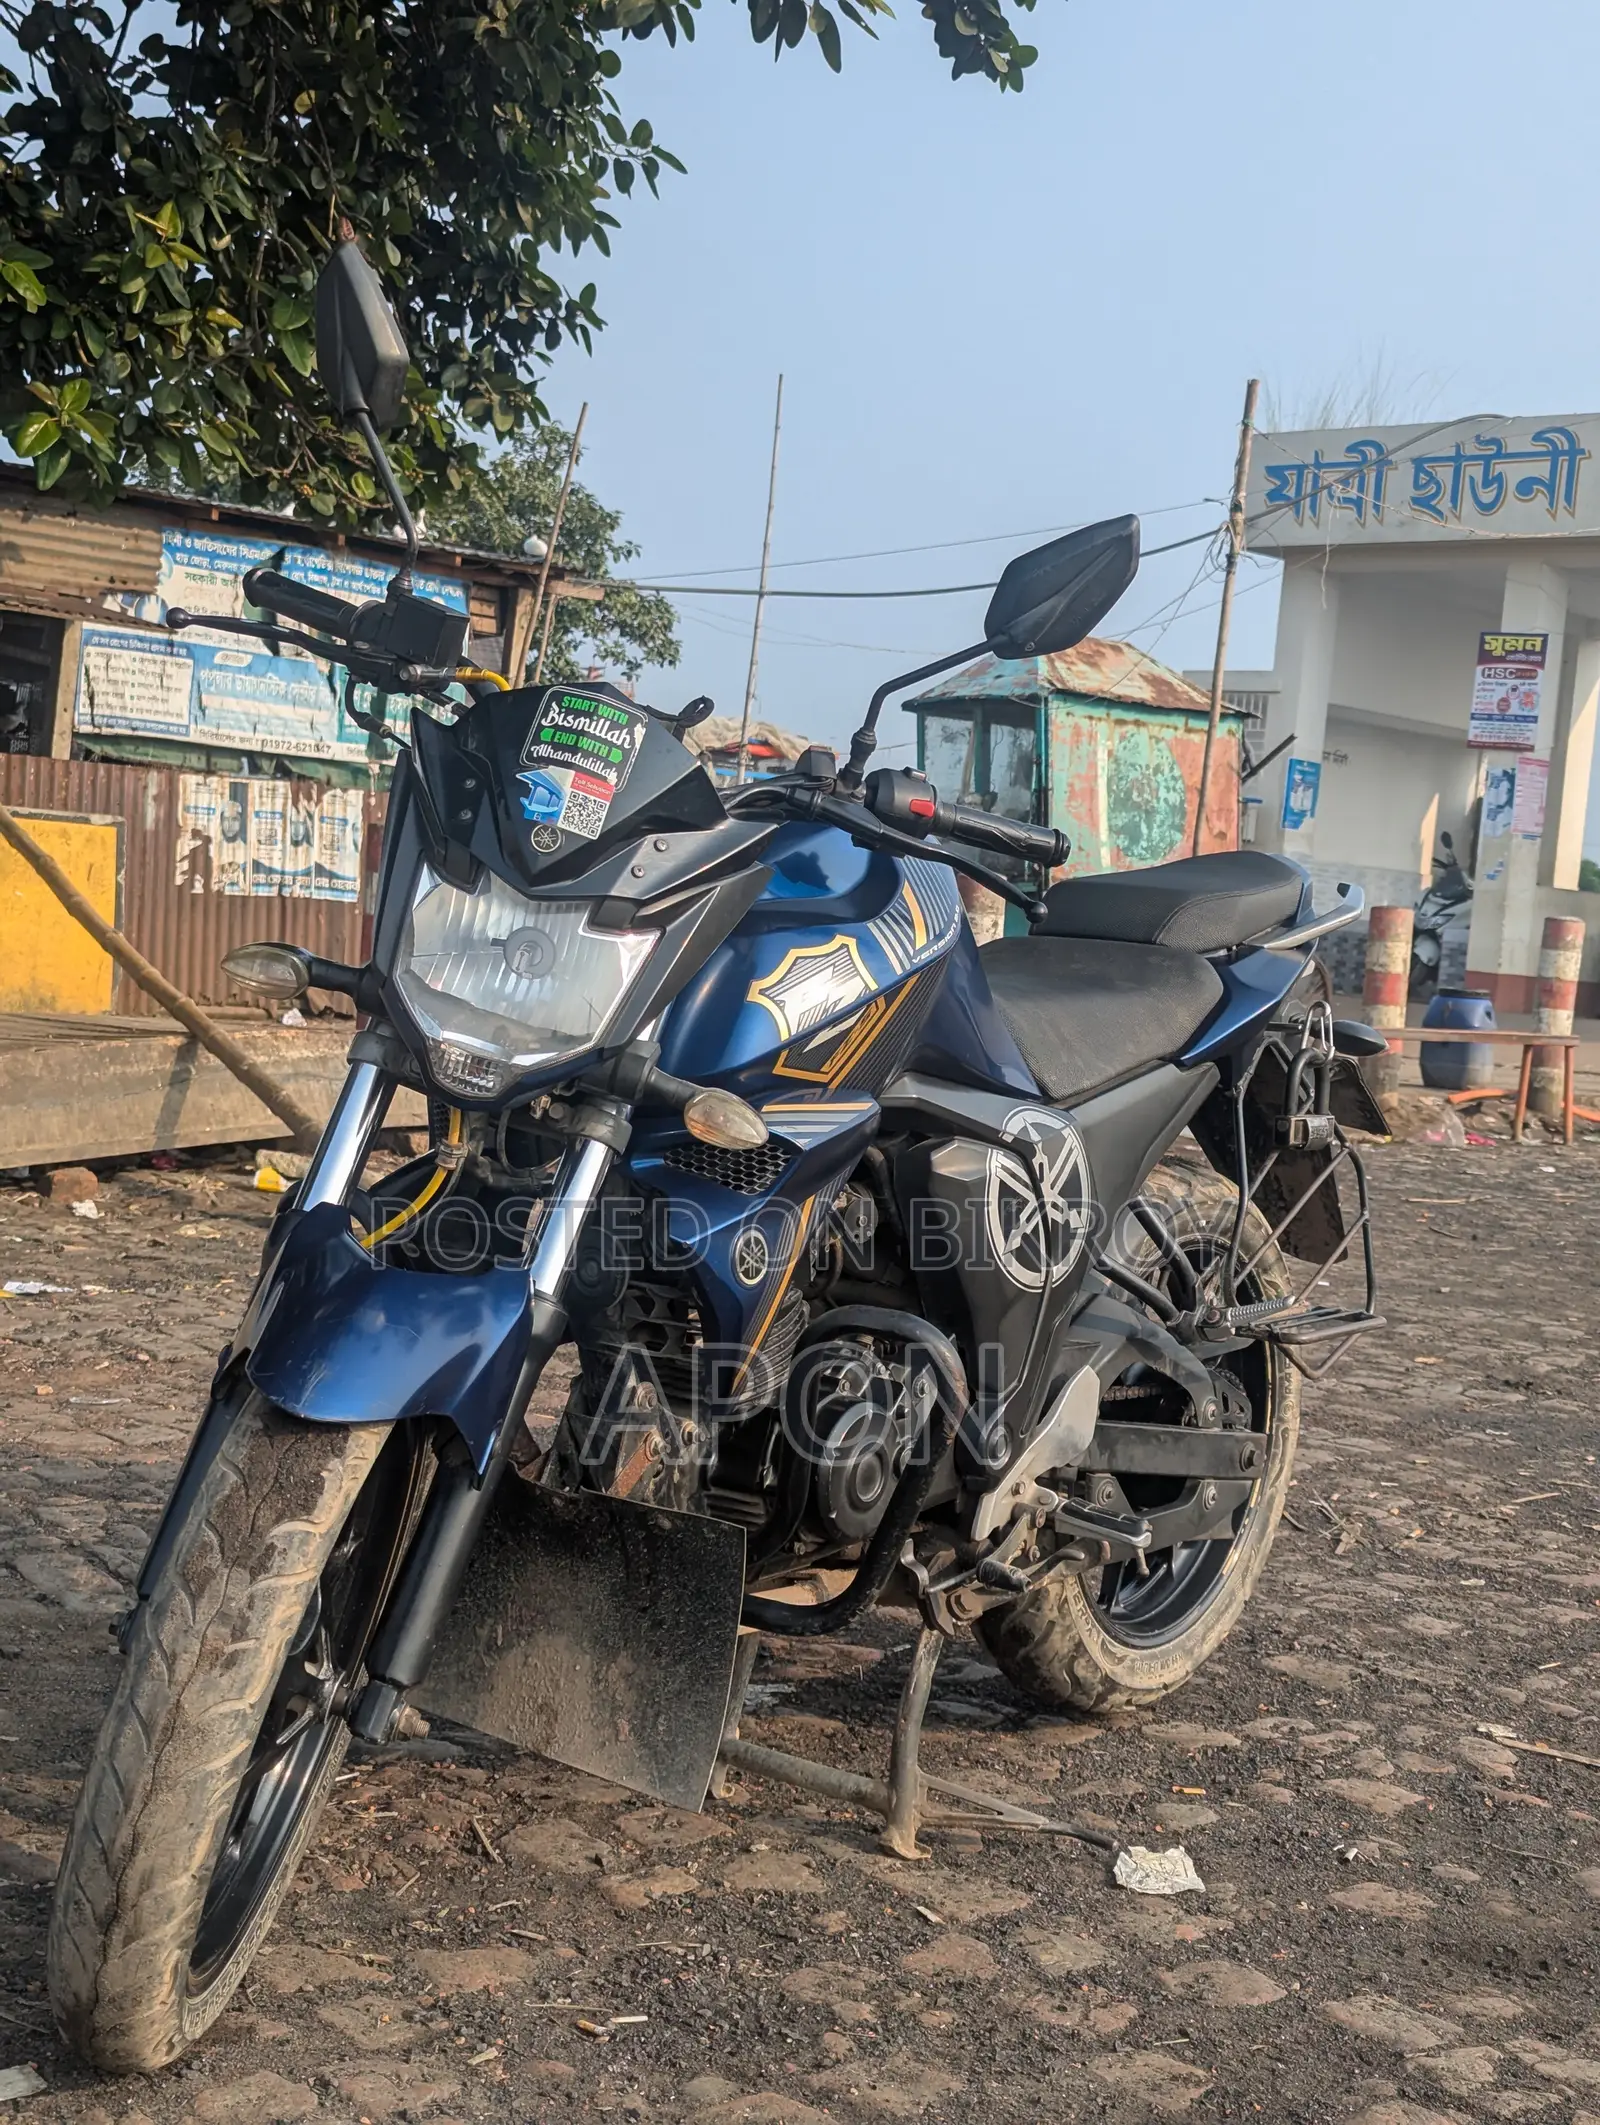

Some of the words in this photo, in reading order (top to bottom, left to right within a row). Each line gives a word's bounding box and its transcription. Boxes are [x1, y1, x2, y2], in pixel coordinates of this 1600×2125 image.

[1264, 438, 1395, 527] যাত্রী
[1408, 425, 1588, 521] ছাউনী
[184, 570, 218, 587] সহকারী
[1483, 635, 1544, 656] সুমন
[1483, 668, 1517, 679] HSC
[541, 701, 632, 749] Bismillah
[561, 695, 598, 713] START
[597, 703, 629, 726] WITH
[553, 731, 577, 746] END
[577, 736, 610, 758] WITH
[530, 743, 618, 779] Alhamdulillah
[912, 922, 957, 963] VERSION
